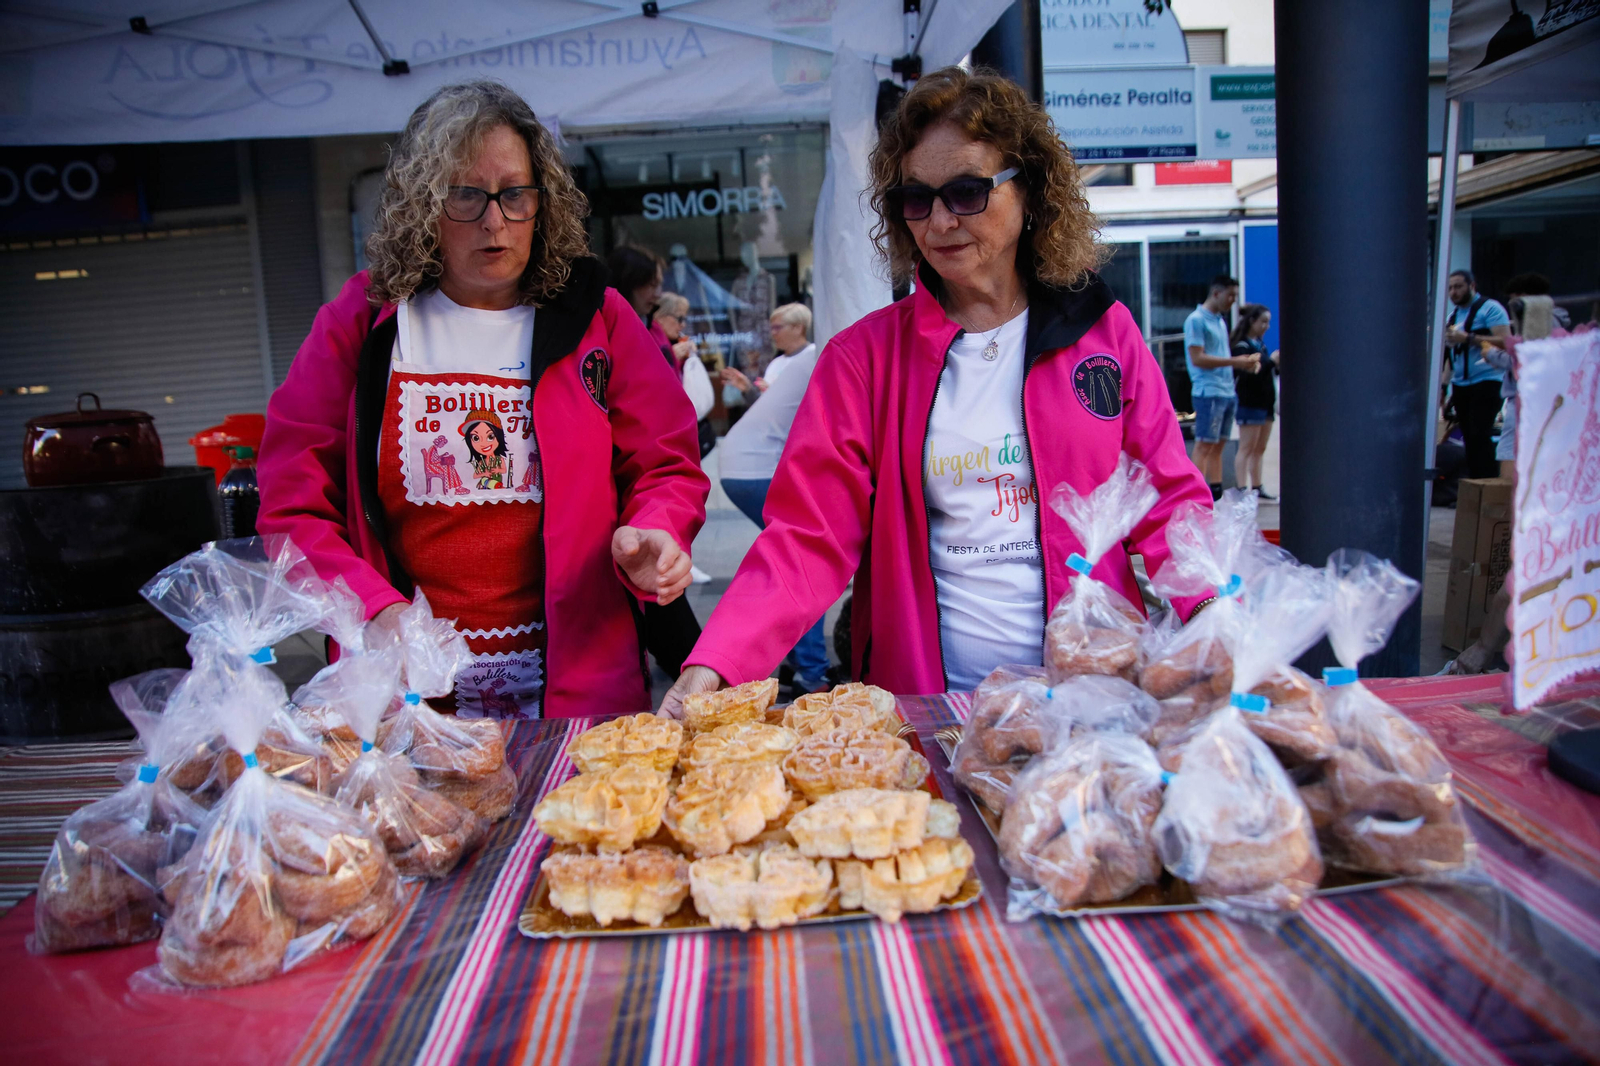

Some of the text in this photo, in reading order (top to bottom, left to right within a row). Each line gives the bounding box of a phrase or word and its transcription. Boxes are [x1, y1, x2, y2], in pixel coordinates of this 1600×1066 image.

[1041, 13, 1077, 30] ICA
[1128, 88, 1192, 105] Peralta
[642, 184, 787, 222] SIMORRA
[415, 416, 441, 433] de
[998, 433, 1025, 466] de
[947, 544, 979, 555] FIESTA
[983, 543, 996, 554] DE
